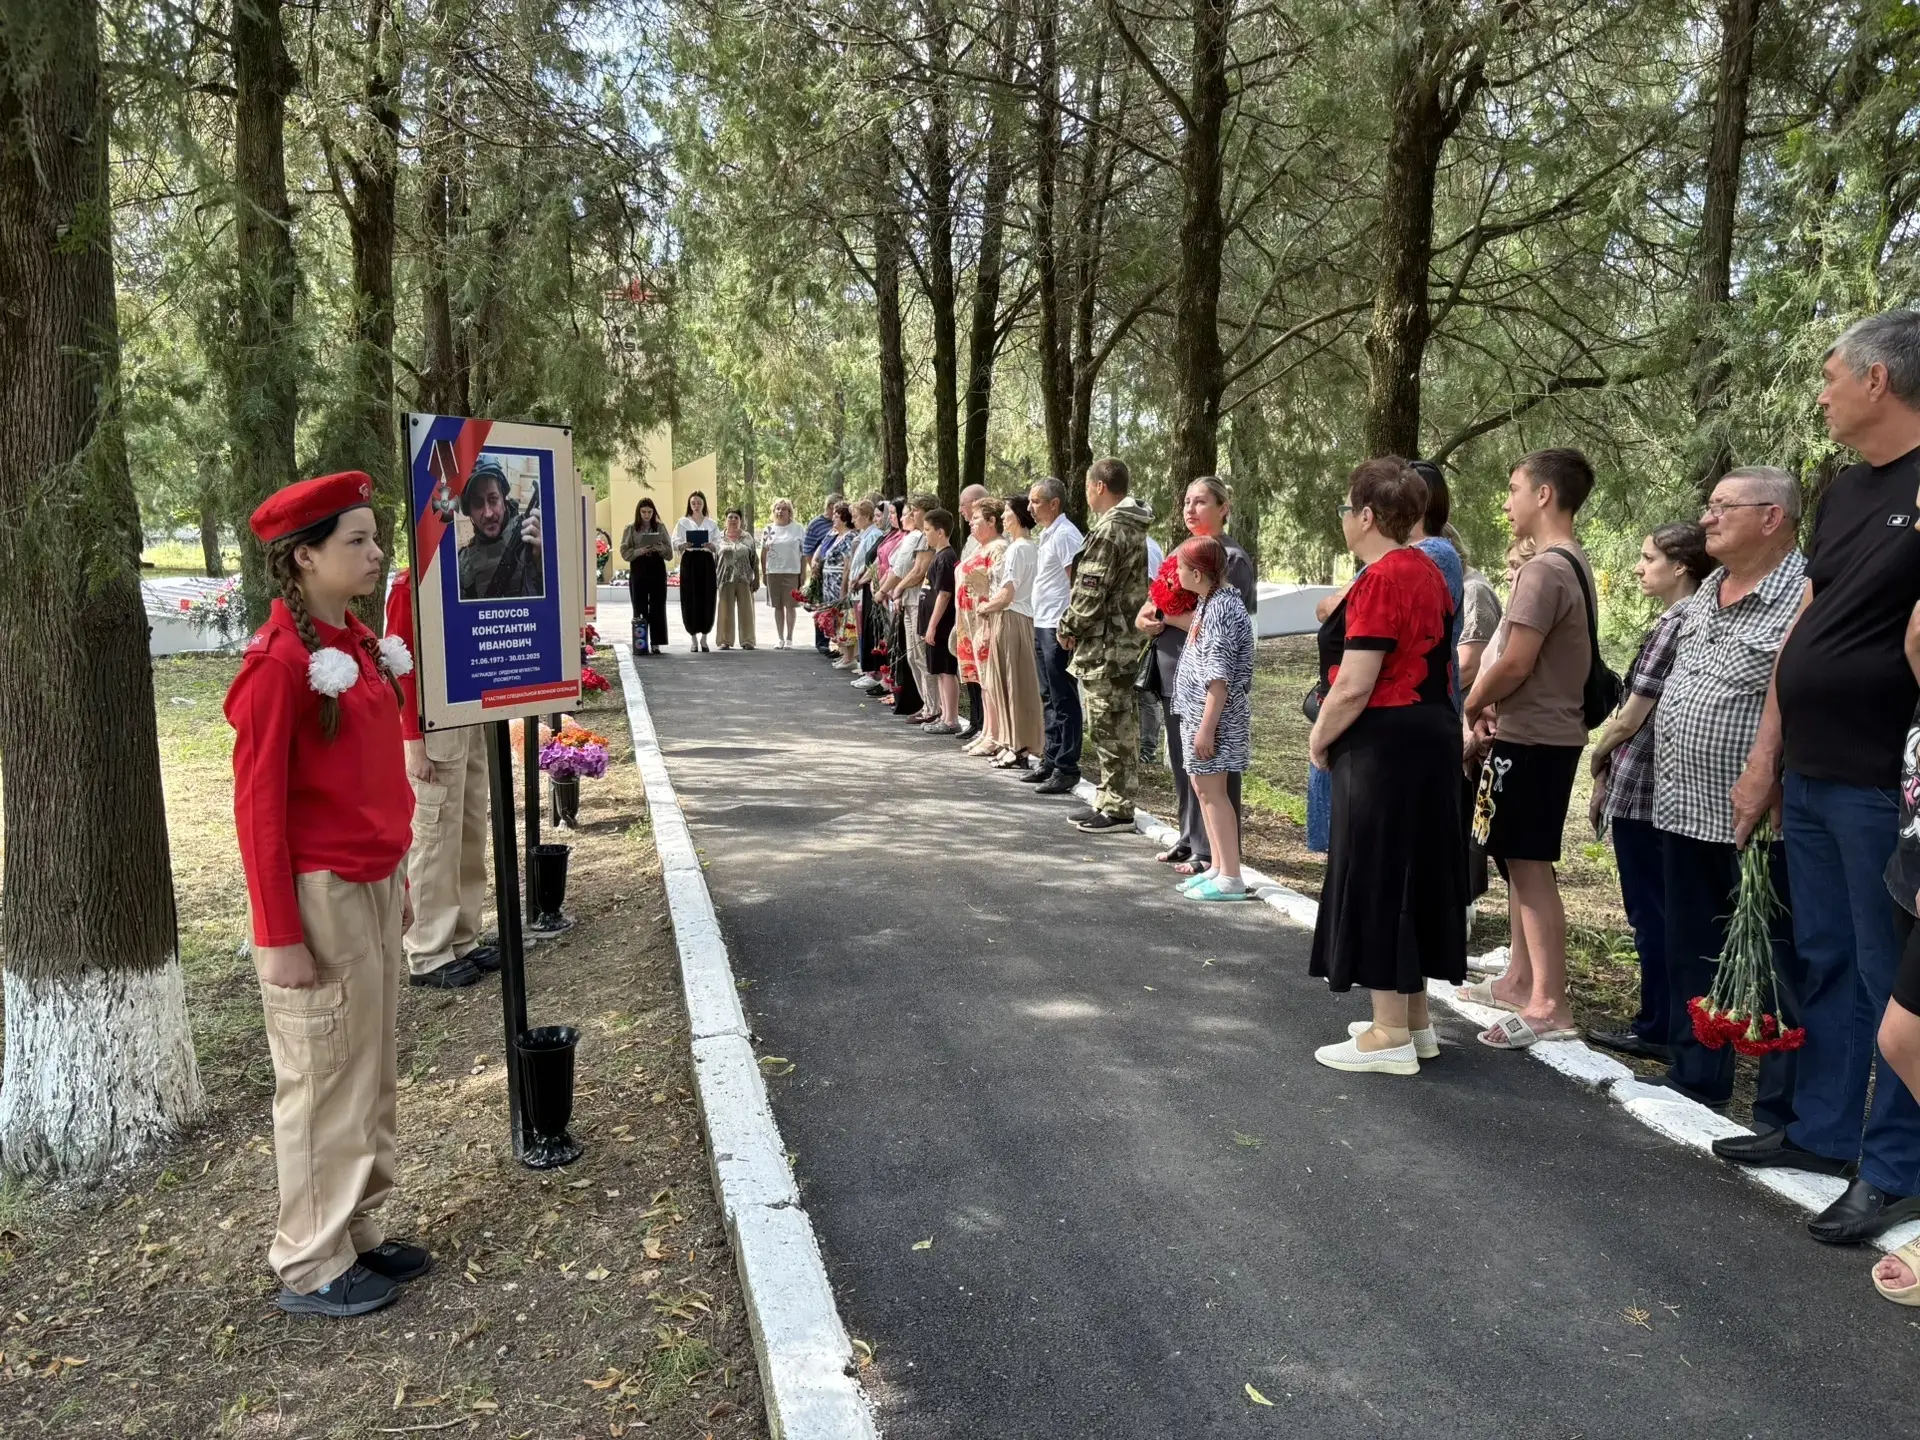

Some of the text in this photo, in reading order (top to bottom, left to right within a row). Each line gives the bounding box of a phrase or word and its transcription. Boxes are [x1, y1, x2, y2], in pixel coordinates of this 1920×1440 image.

[478, 608, 530, 620] БЕЛОУСОВ
[471, 622, 537, 636] КОНСТАНТИН
[478, 638, 532, 651] ИВАНОВИЧ
[470, 656, 504, 666] 21.06.1973
[508, 652, 541, 662] 30.03.2025
[484, 694, 507, 702] УЧАСТНИК
[506, 690, 537, 700] СПЕЦИАЛЬНОЙ
